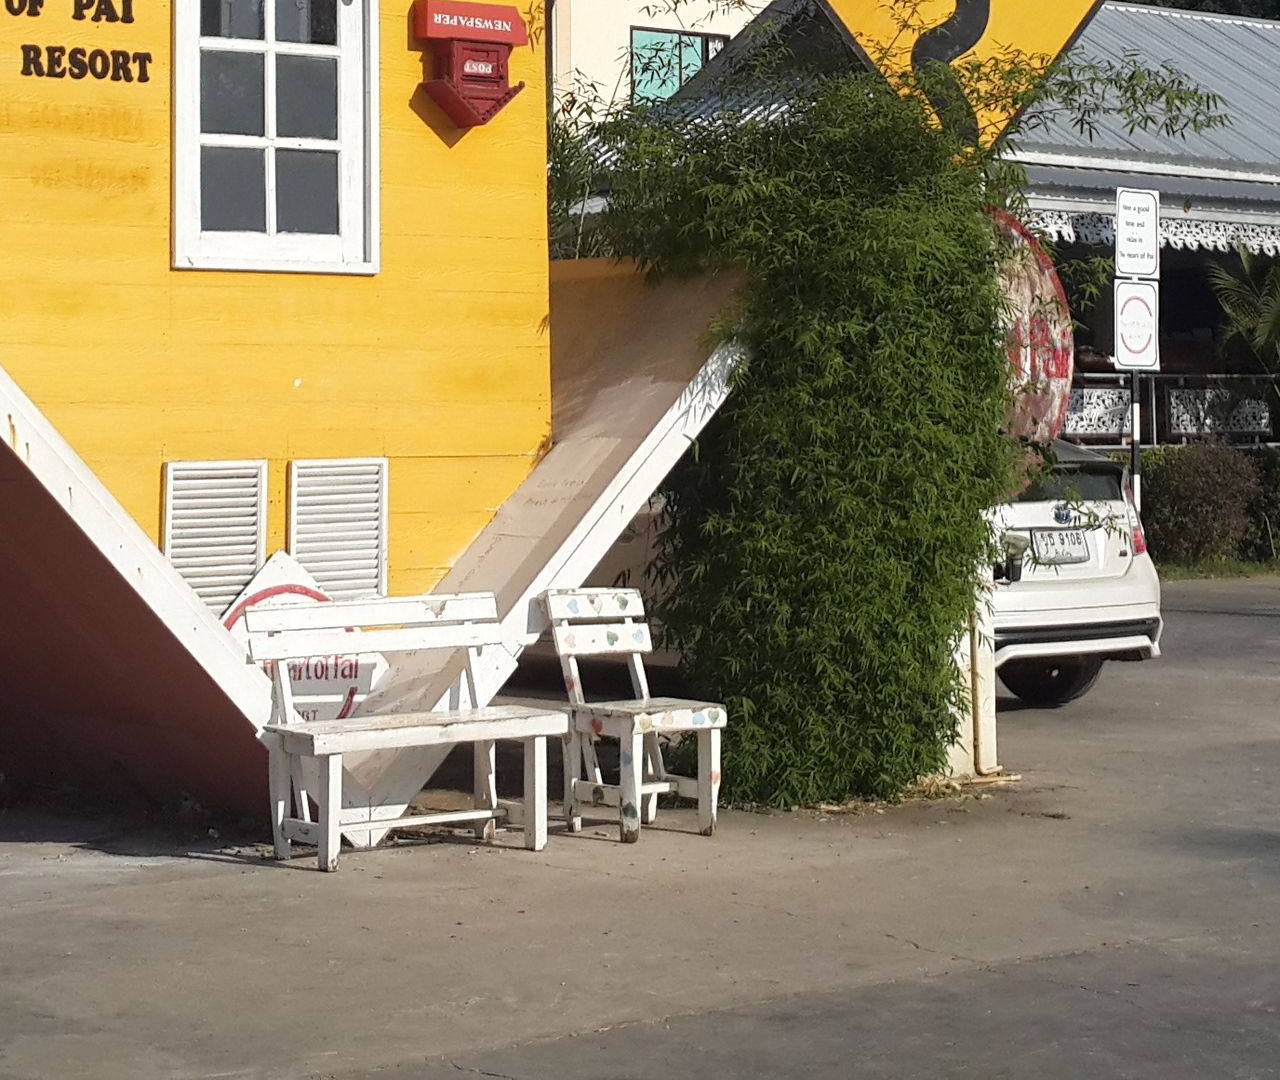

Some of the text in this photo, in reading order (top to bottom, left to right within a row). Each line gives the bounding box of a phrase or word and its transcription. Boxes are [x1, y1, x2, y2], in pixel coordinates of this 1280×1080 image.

[432, 12, 512, 32] NEWSPAPER
[20, 44, 153, 83] RESORT
[463, 60, 493, 74] POST
